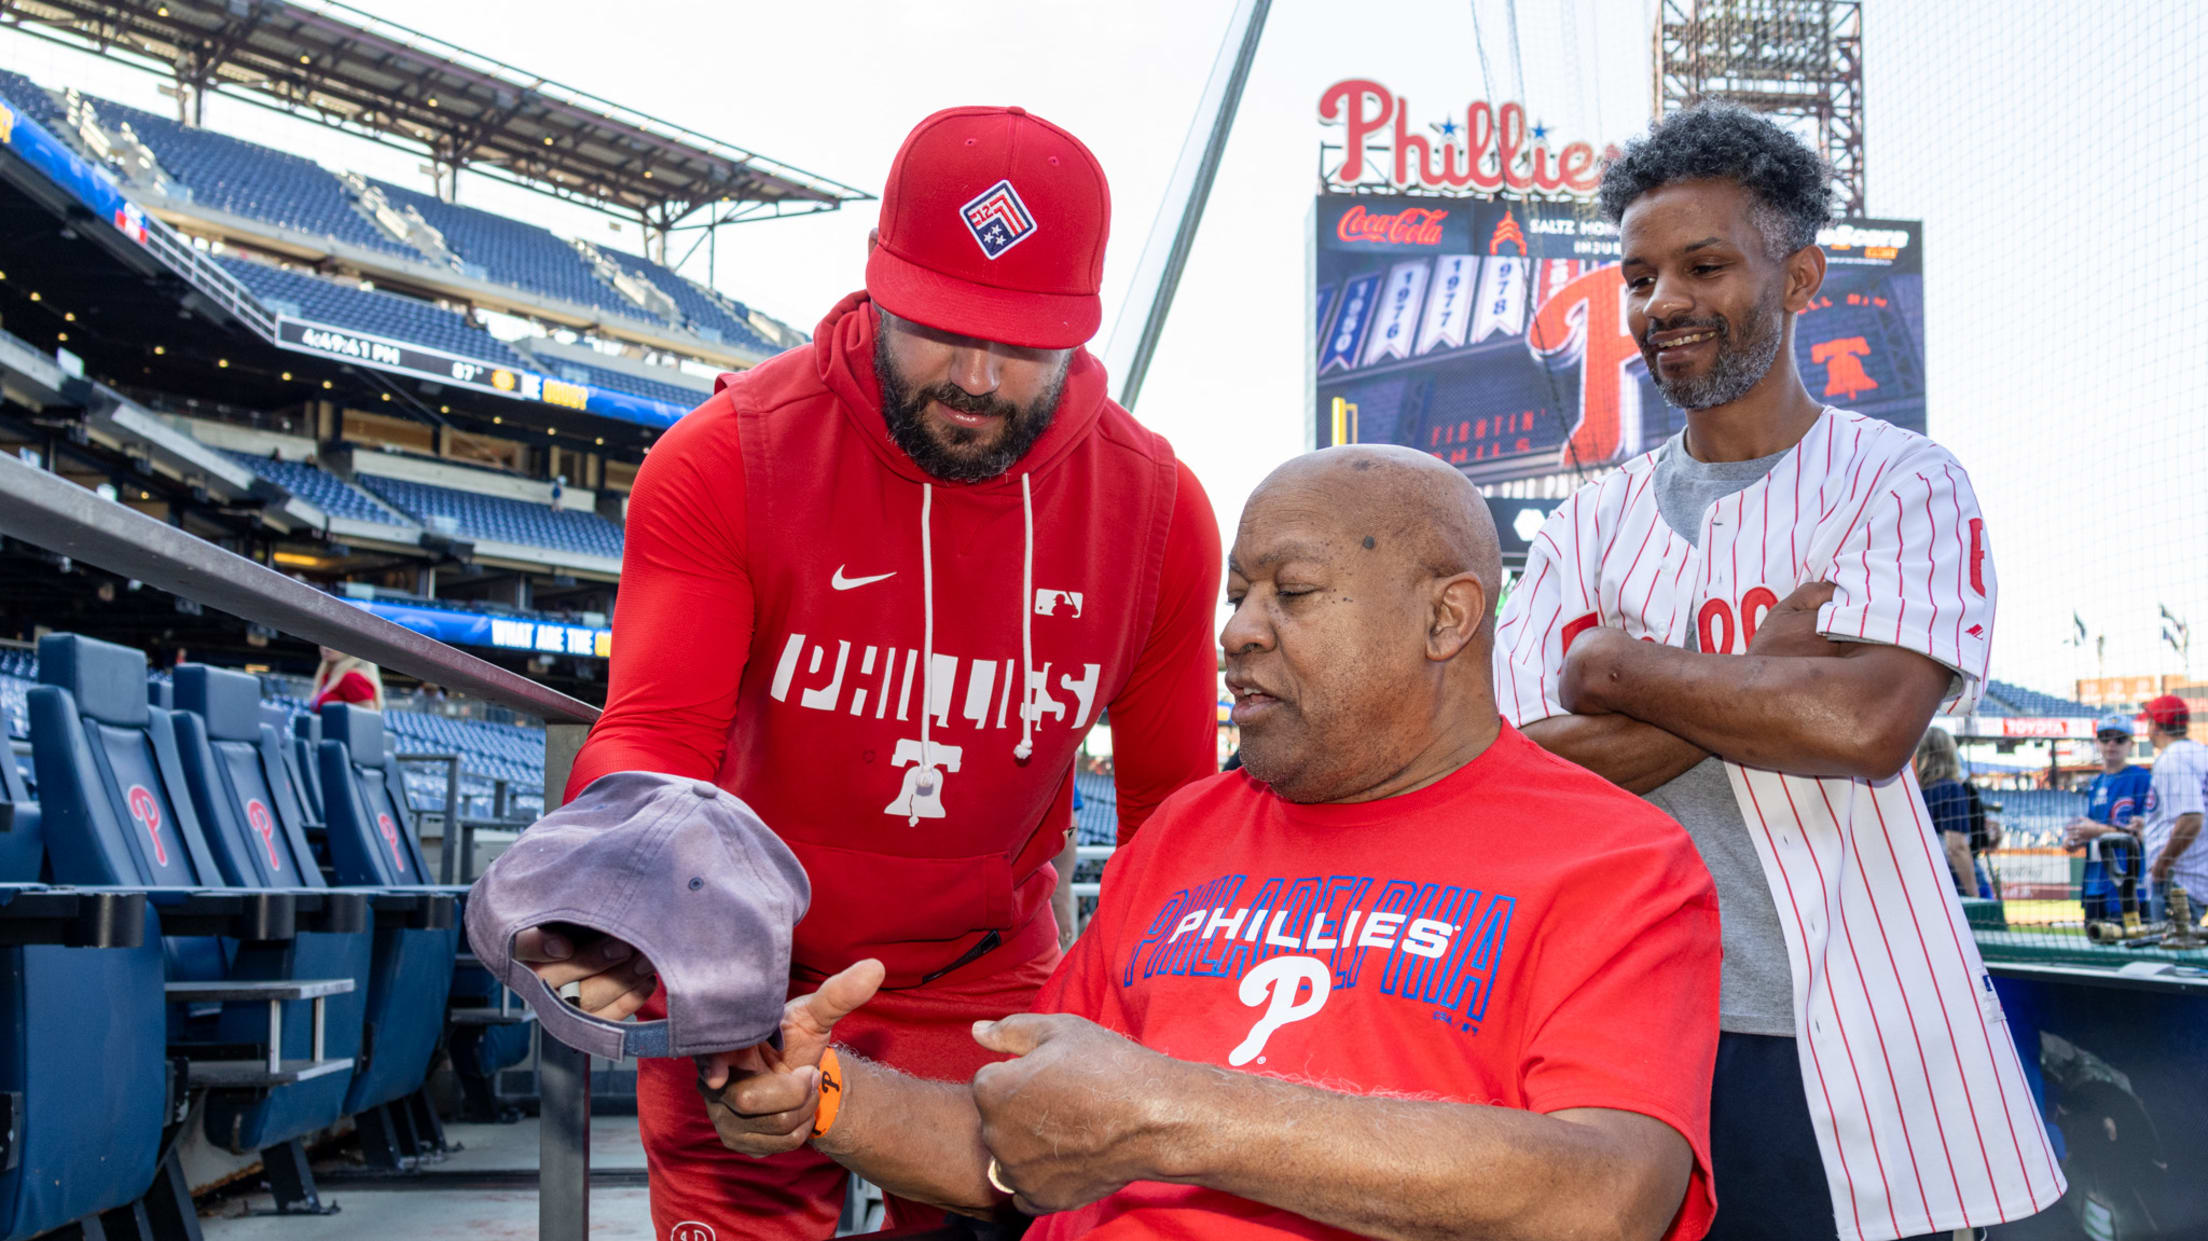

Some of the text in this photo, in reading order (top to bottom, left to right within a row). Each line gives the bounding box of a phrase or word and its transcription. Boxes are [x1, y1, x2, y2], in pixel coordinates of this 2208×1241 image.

[1318, 78, 1625, 190] Phillie
[1337, 205, 1448, 245] Coca-Cola
[1529, 218, 1576, 235] SALTZ
[1386, 271, 1414, 339] 1976
[1440, 258, 1462, 328] 1977
[371, 342, 400, 366] PM
[491, 619, 534, 649] WHAT
[535, 623, 565, 653] ARE
[566, 627, 594, 656] THE
[770, 633, 1101, 731] PHILLIES
[1168, 907, 1457, 959] PHILLIES
[1228, 956, 1332, 1066] P
